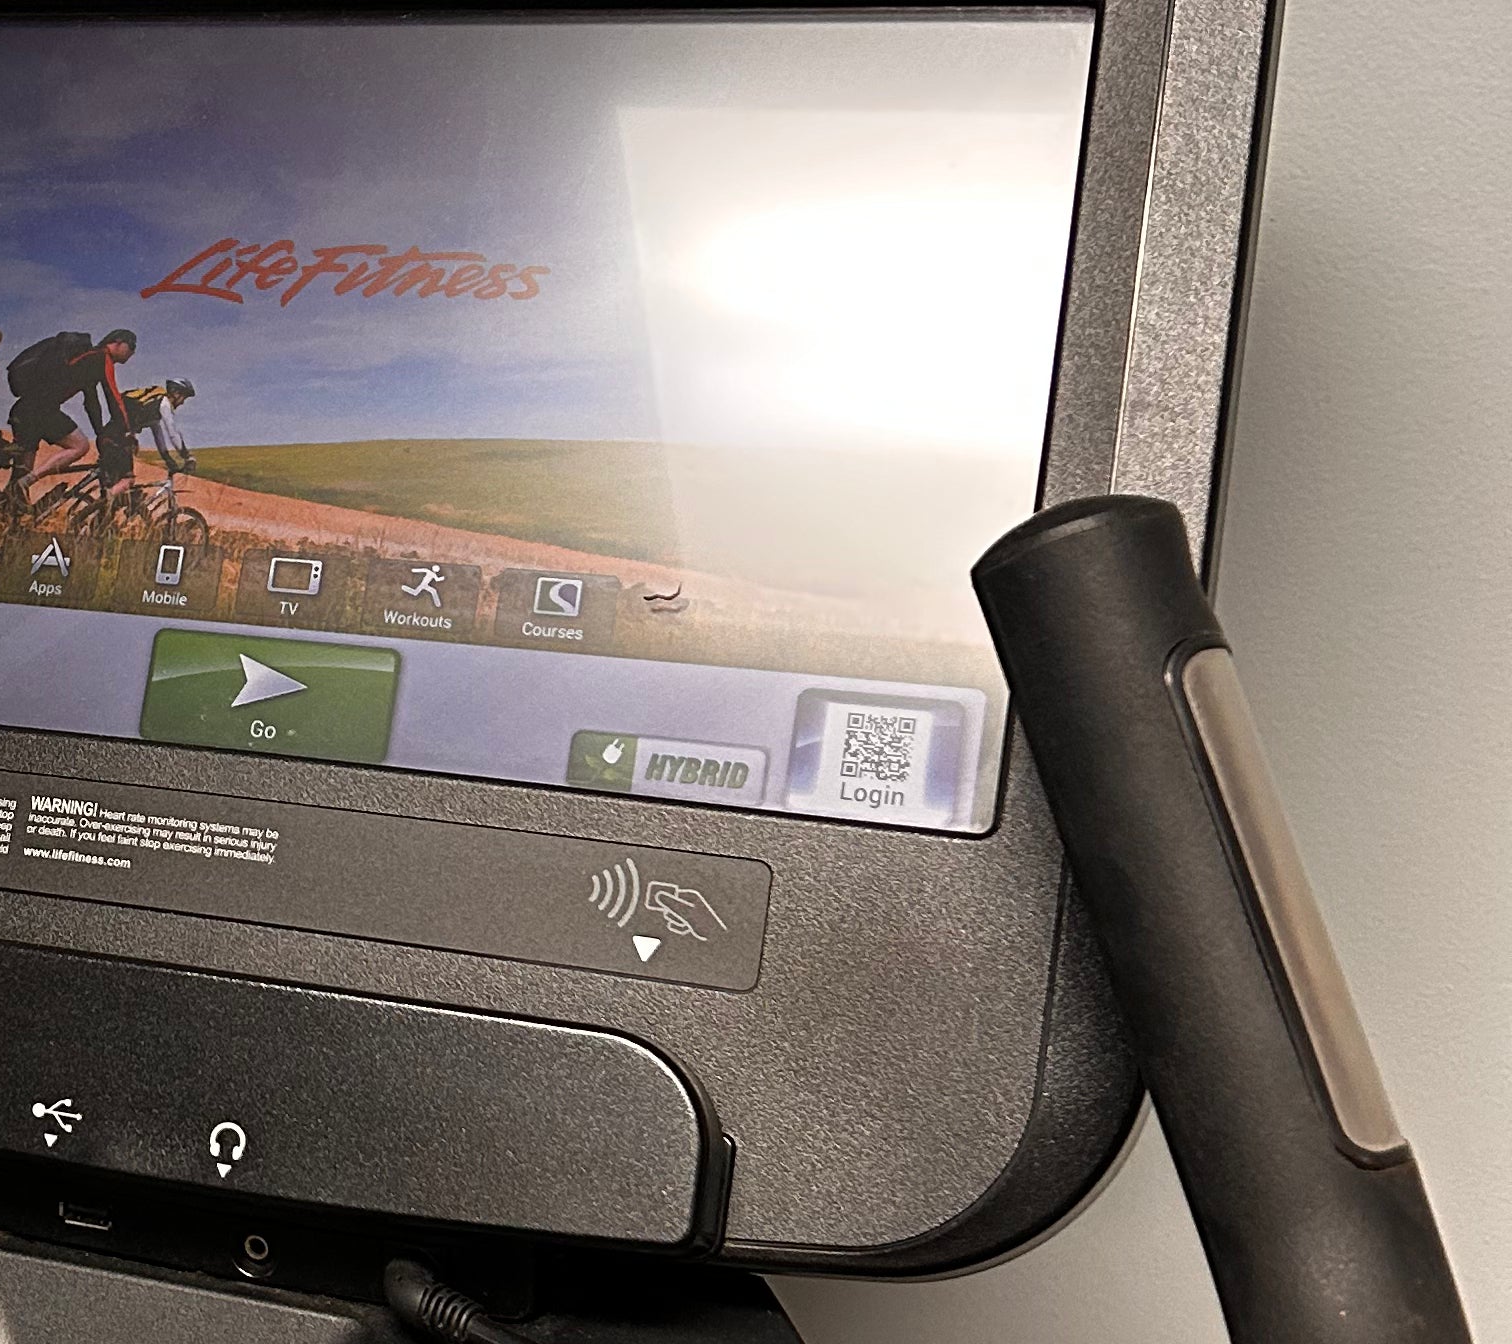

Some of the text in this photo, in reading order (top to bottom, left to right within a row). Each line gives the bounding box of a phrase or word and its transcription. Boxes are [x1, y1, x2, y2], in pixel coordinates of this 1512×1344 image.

[29, 580, 62, 598] Apps
[142, 588, 188, 607] Mobile
[278, 601, 299, 616] TV
[383, 609, 453, 631] Workouts
[521, 621, 584, 641] Courses
[249, 719, 277, 741] Go
[644, 752, 750, 791] HYBRID
[839, 781, 906, 808] Login
[31, 795, 279, 840] WARNING! Heart rate monitoring systems may be
[0, 833, 12, 842] all
[26, 825, 36, 834] or
[70, 828, 77, 839] If
[77, 832, 96, 841] you
[97, 832, 116, 843] feel
[117, 834, 138, 846] faint
[139, 838, 161, 851] stop
[162, 842, 213, 857] exercising
[214, 846, 276, 864] immediately.
[153, 829, 174, 840] may
[175, 832, 201, 842] result
[203, 833, 211, 843] in
[214, 836, 248, 847] serious
[250, 839, 278, 853] injury
[24, 847, 131, 868] www.lifefitness.com
